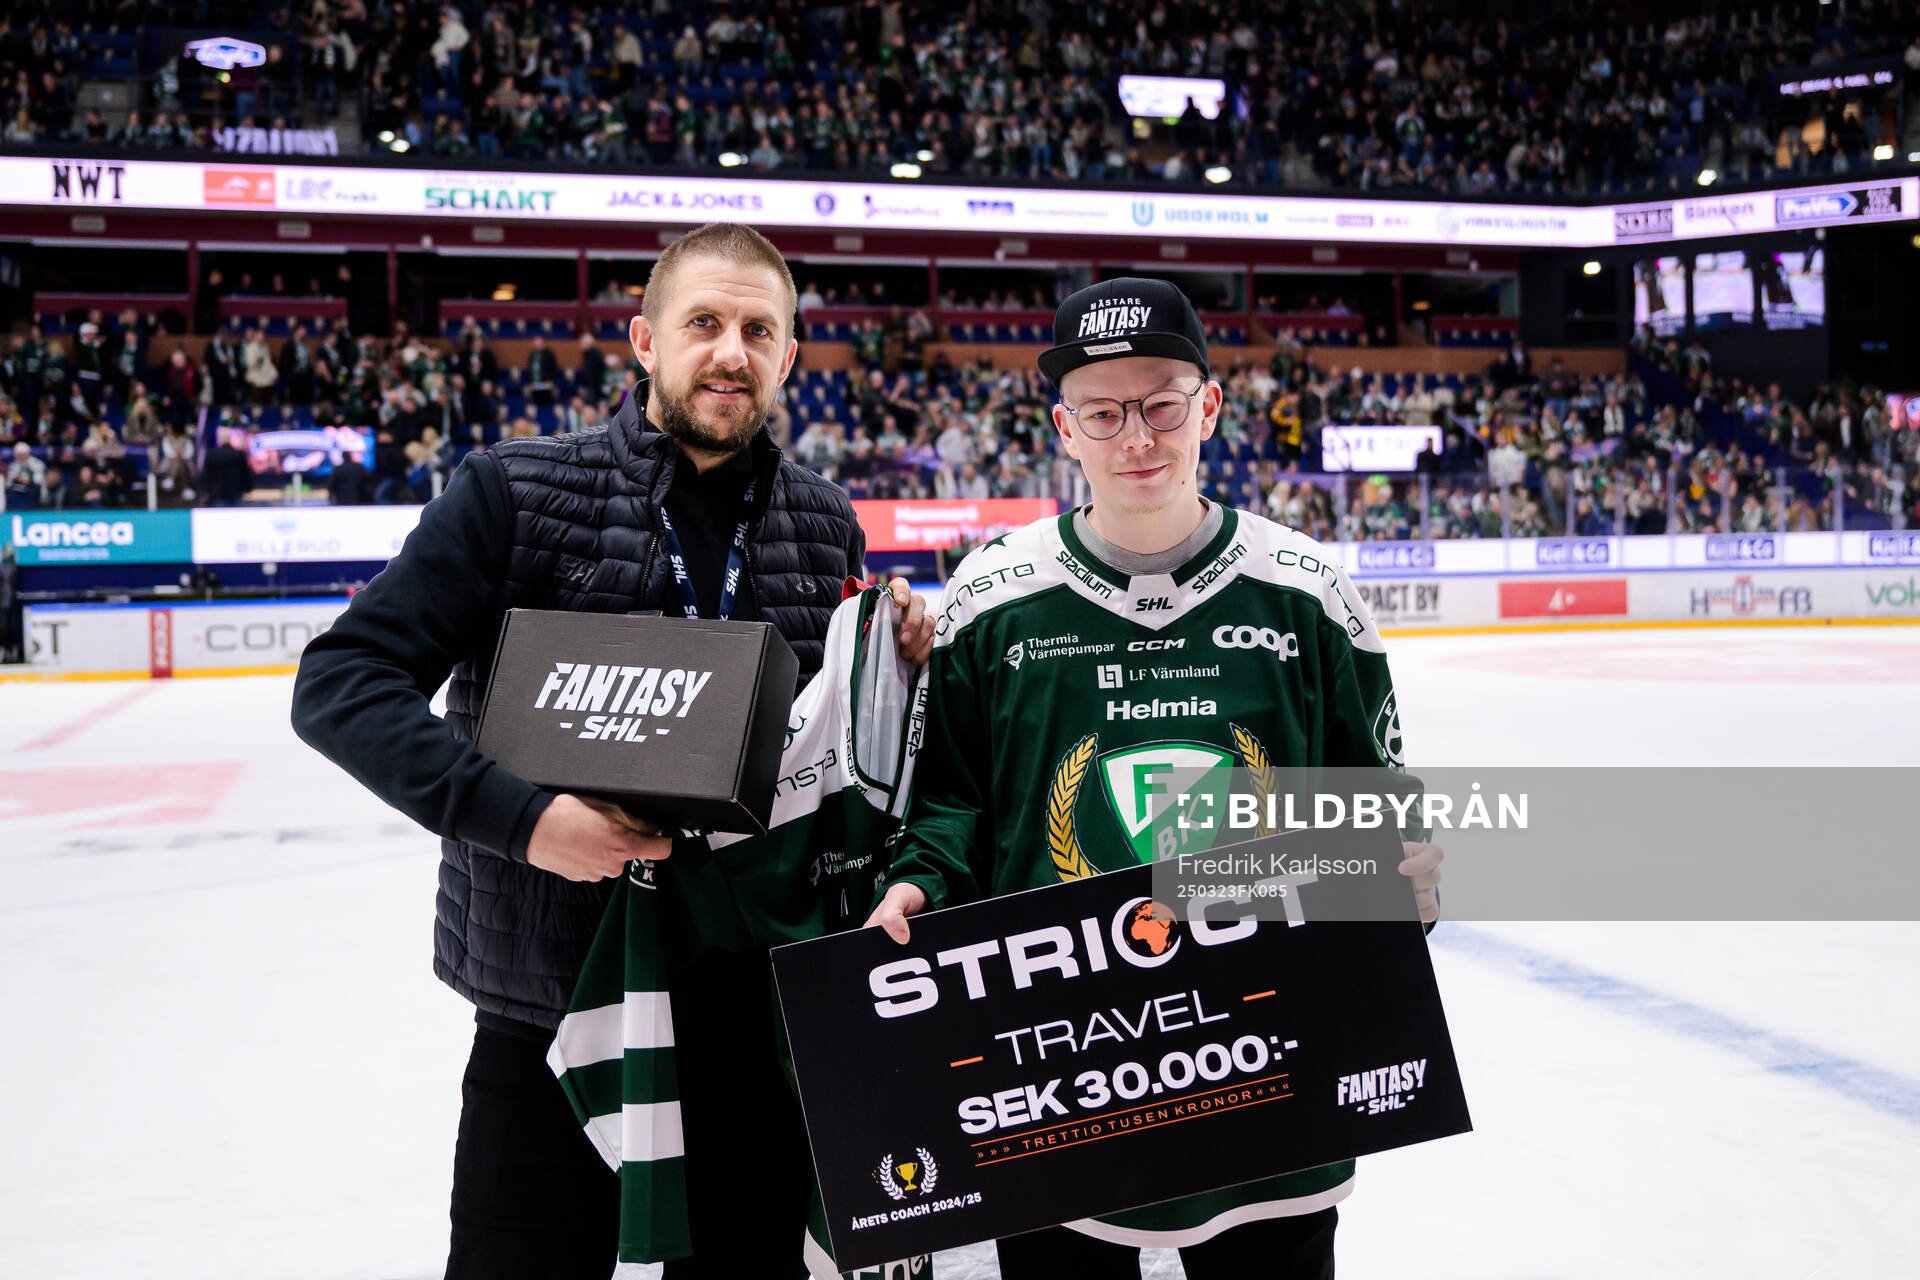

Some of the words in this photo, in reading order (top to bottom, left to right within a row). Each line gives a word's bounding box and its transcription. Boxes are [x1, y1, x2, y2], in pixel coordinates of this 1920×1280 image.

[52, 164, 125, 200] NWT
[424, 187, 556, 212] SCHAKT
[1090, 298, 1141, 311] MÄSTARE
[1078, 306, 1152, 338] FANTASY
[12, 515, 135, 547] Lancea
[734, 520, 749, 550] SHL
[670, 554, 688, 585] SHL
[725, 567, 740, 596] SHL
[1055, 550, 1116, 600] stadium
[1191, 542, 1248, 595] stadium
[1135, 596, 1174, 612] SHL
[1416, 583, 1439, 609] BY
[1027, 632, 1079, 649] Thermia
[1029, 641, 1116, 660] Värmepumpar
[1127, 638, 1186, 652] CCM
[1212, 624, 1300, 662] coop
[1129, 668, 1147, 682] LF
[1150, 664, 1221, 681] Värmland
[534, 662, 713, 718] FANTASY
[907, 686, 929, 759] stadium
[1107, 695, 1217, 721] Helmia
[994, 990, 1230, 1065] TRAVEL
[957, 1077, 1073, 1135] SEK
[1074, 1034, 1299, 1109] 30.000:-
[1337, 1058, 1427, 1106] FANTASY
[1022, 1123, 1102, 1151] TRETTIO
[1107, 1109, 1169, 1131] TUSEN
[1174, 1090, 1253, 1116] KRONOR
[851, 1213, 889, 1230] ÅRETS
[890, 1203, 931, 1222] COACH
[932, 1191, 982, 1213] 2024/25
